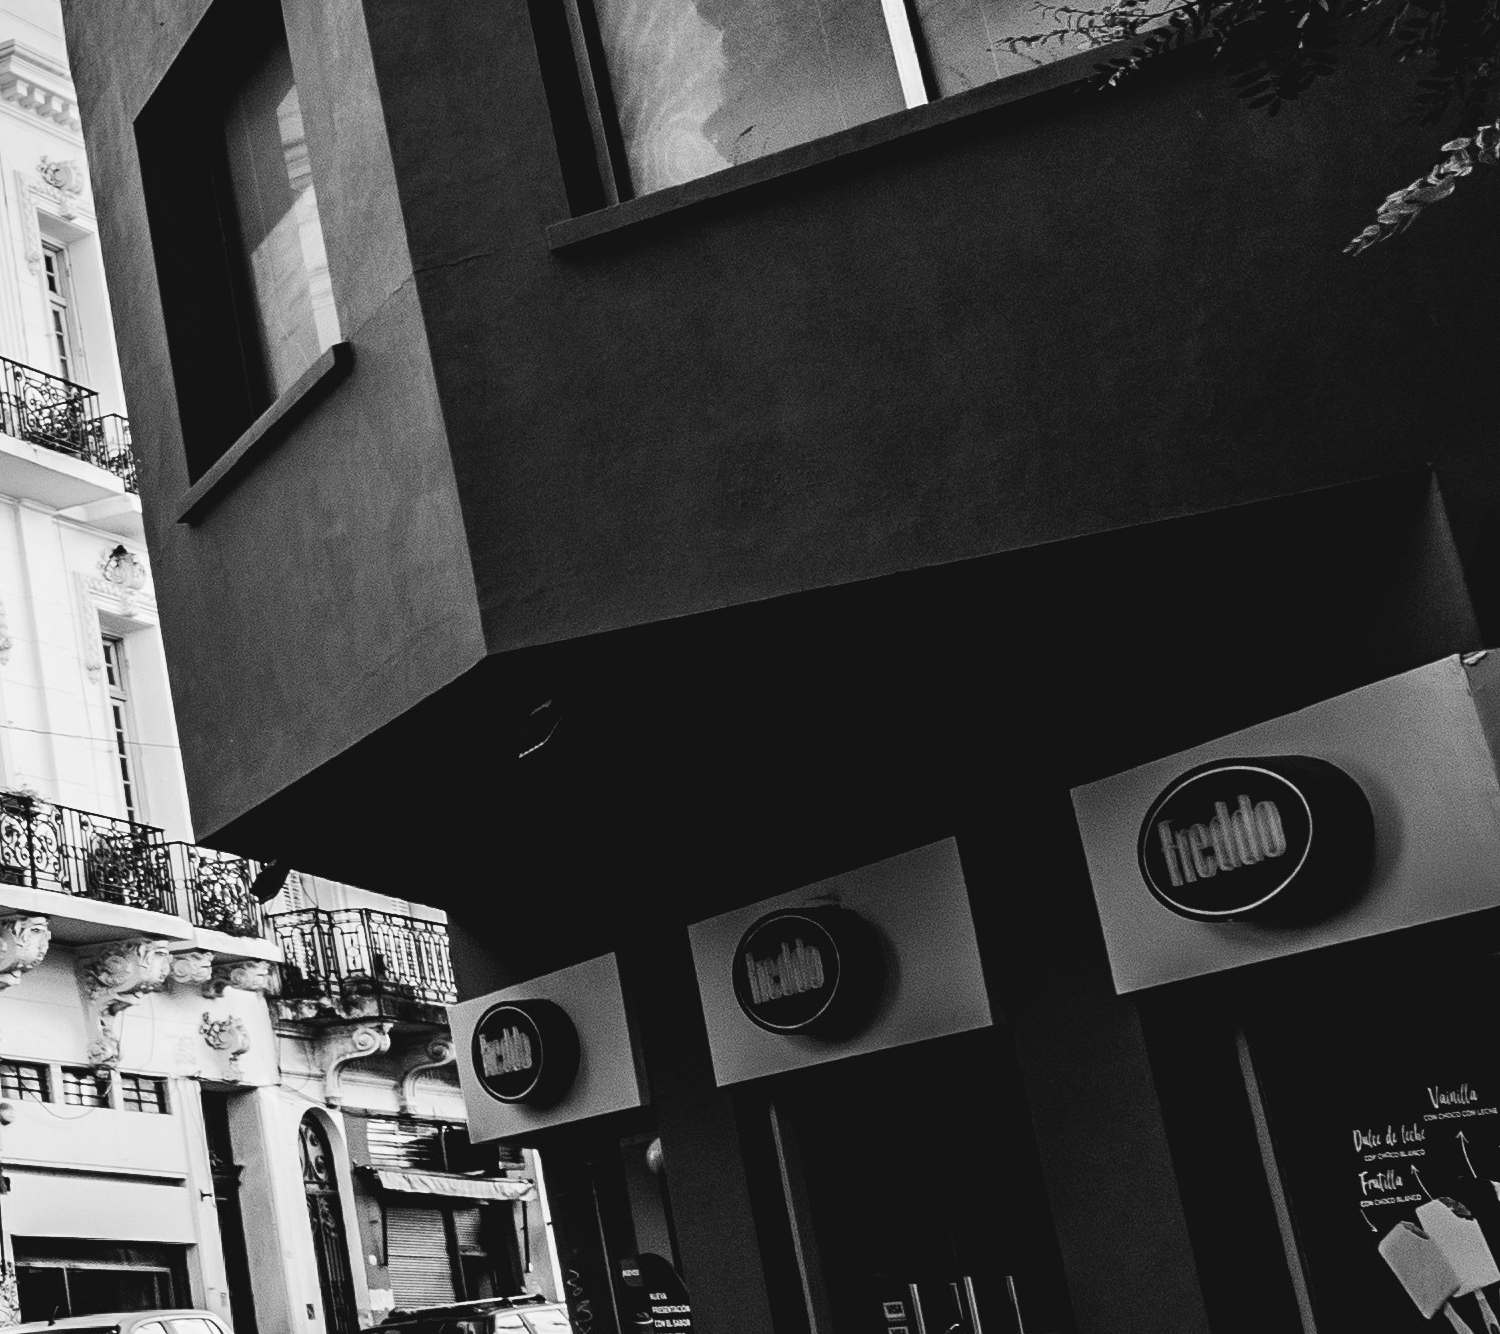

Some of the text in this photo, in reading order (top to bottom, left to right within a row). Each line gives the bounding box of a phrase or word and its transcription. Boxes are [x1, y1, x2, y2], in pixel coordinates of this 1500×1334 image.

[1427, 1083, 1478, 1109] Vainilla
[1353, 1123, 1426, 1153] Dulce de leche
[1399, 1148, 1426, 1158] BLANCO
[1358, 1170, 1404, 1196] Frutilla
[1396, 1193, 1422, 1203] BLANCO
[652, 1305, 691, 1314] PRESENTACIÓN
[673, 1319, 692, 1327] SABOR
